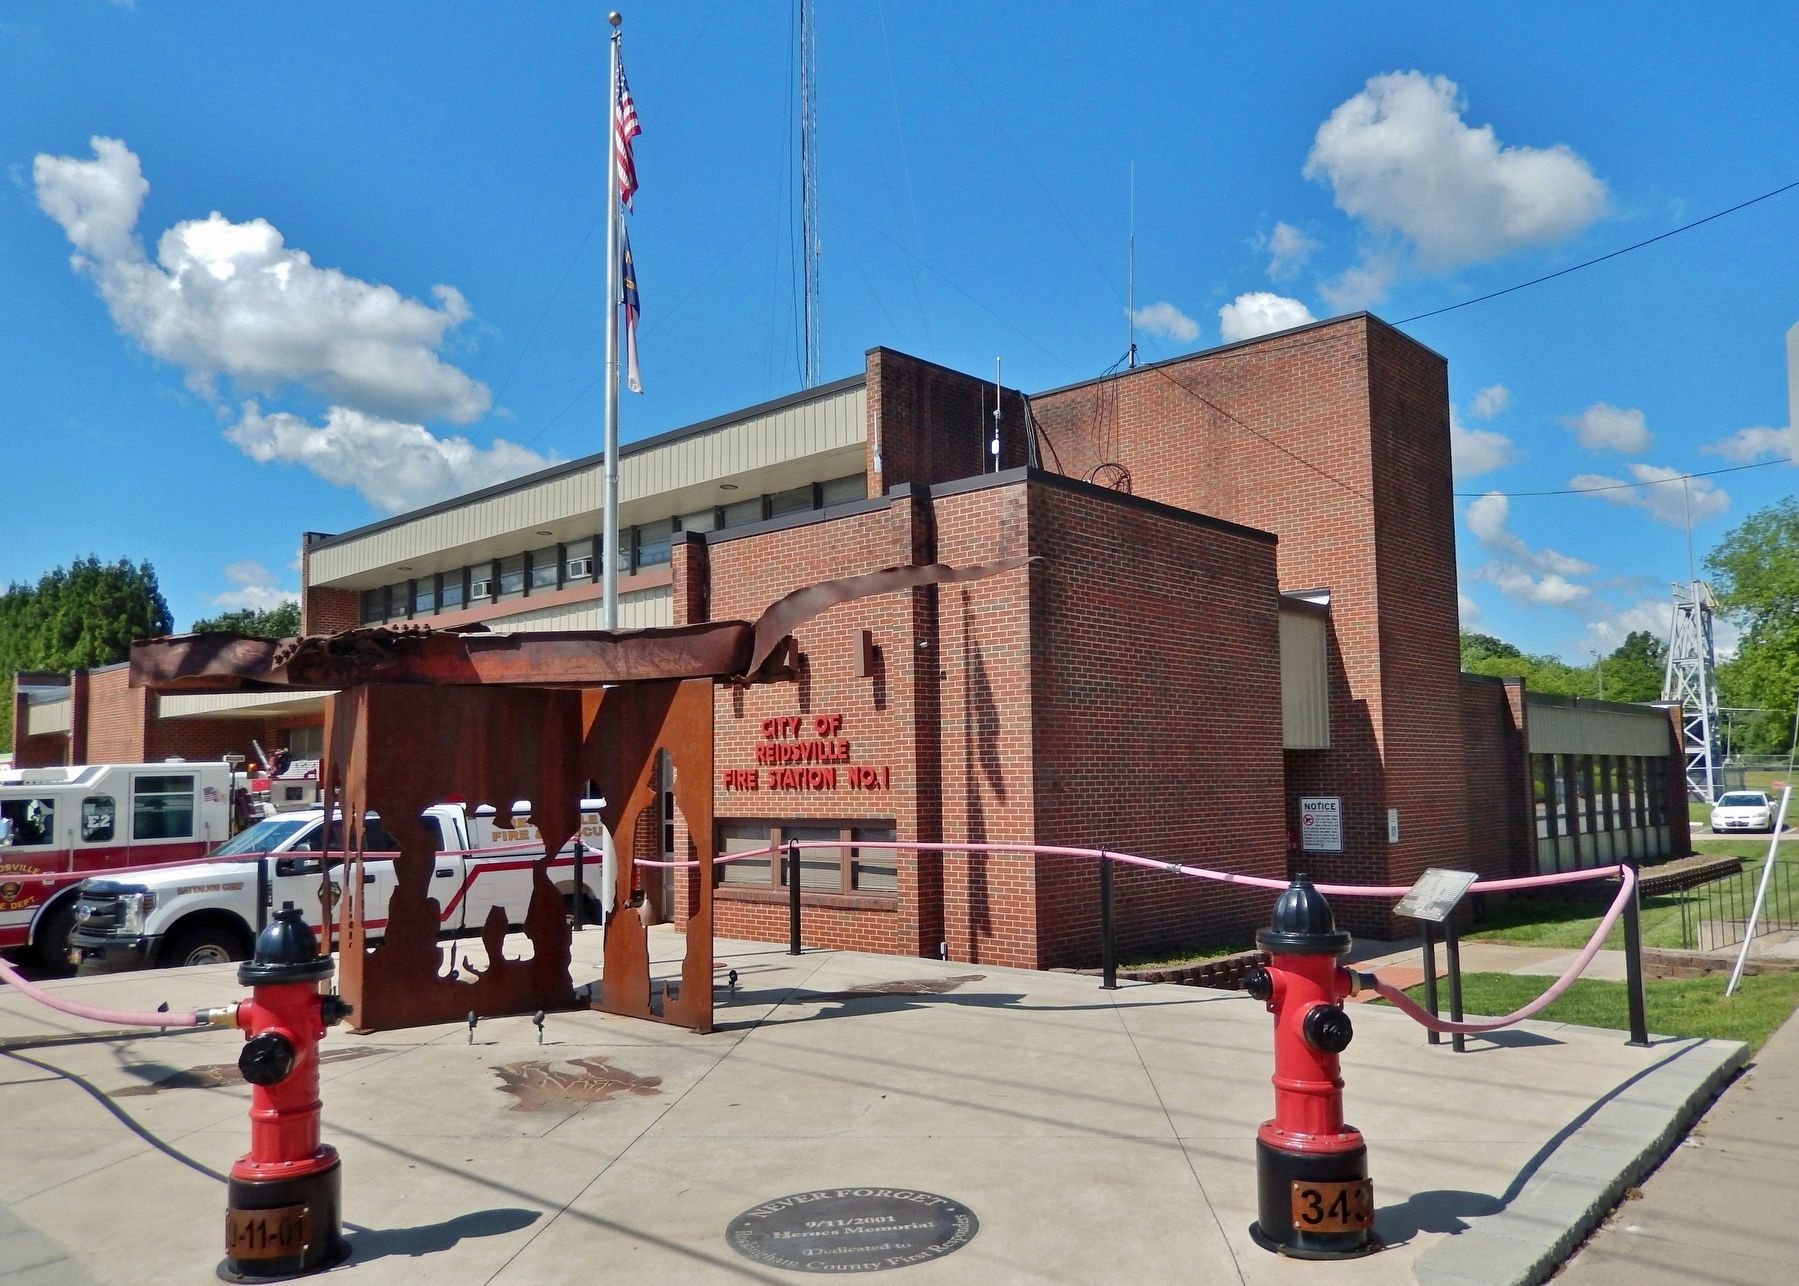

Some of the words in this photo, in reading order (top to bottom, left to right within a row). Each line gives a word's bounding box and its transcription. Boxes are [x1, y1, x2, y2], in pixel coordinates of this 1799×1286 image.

[761, 716, 801, 738] CITY
[814, 714, 842, 736] OF
[755, 740, 850, 764] REIDSVILLE
[722, 769, 758, 790] FIRE
[768, 767, 836, 790] STATION
[1304, 802, 1336, 810] NOTICE
[87, 815, 111, 828] E2
[492, 830, 530, 842] FIRE
[746, 1192, 833, 1218] NEVER
[836, 1189, 948, 1206] FORGET
[773, 1230, 839, 1239] Heroes
[844, 1221, 936, 1234] Memorial
[805, 1215, 897, 1228] 9/11/2001
[803, 1243, 891, 1256] Dedicated
[806, 1261, 881, 1271] County
[885, 1251, 933, 1265] First
